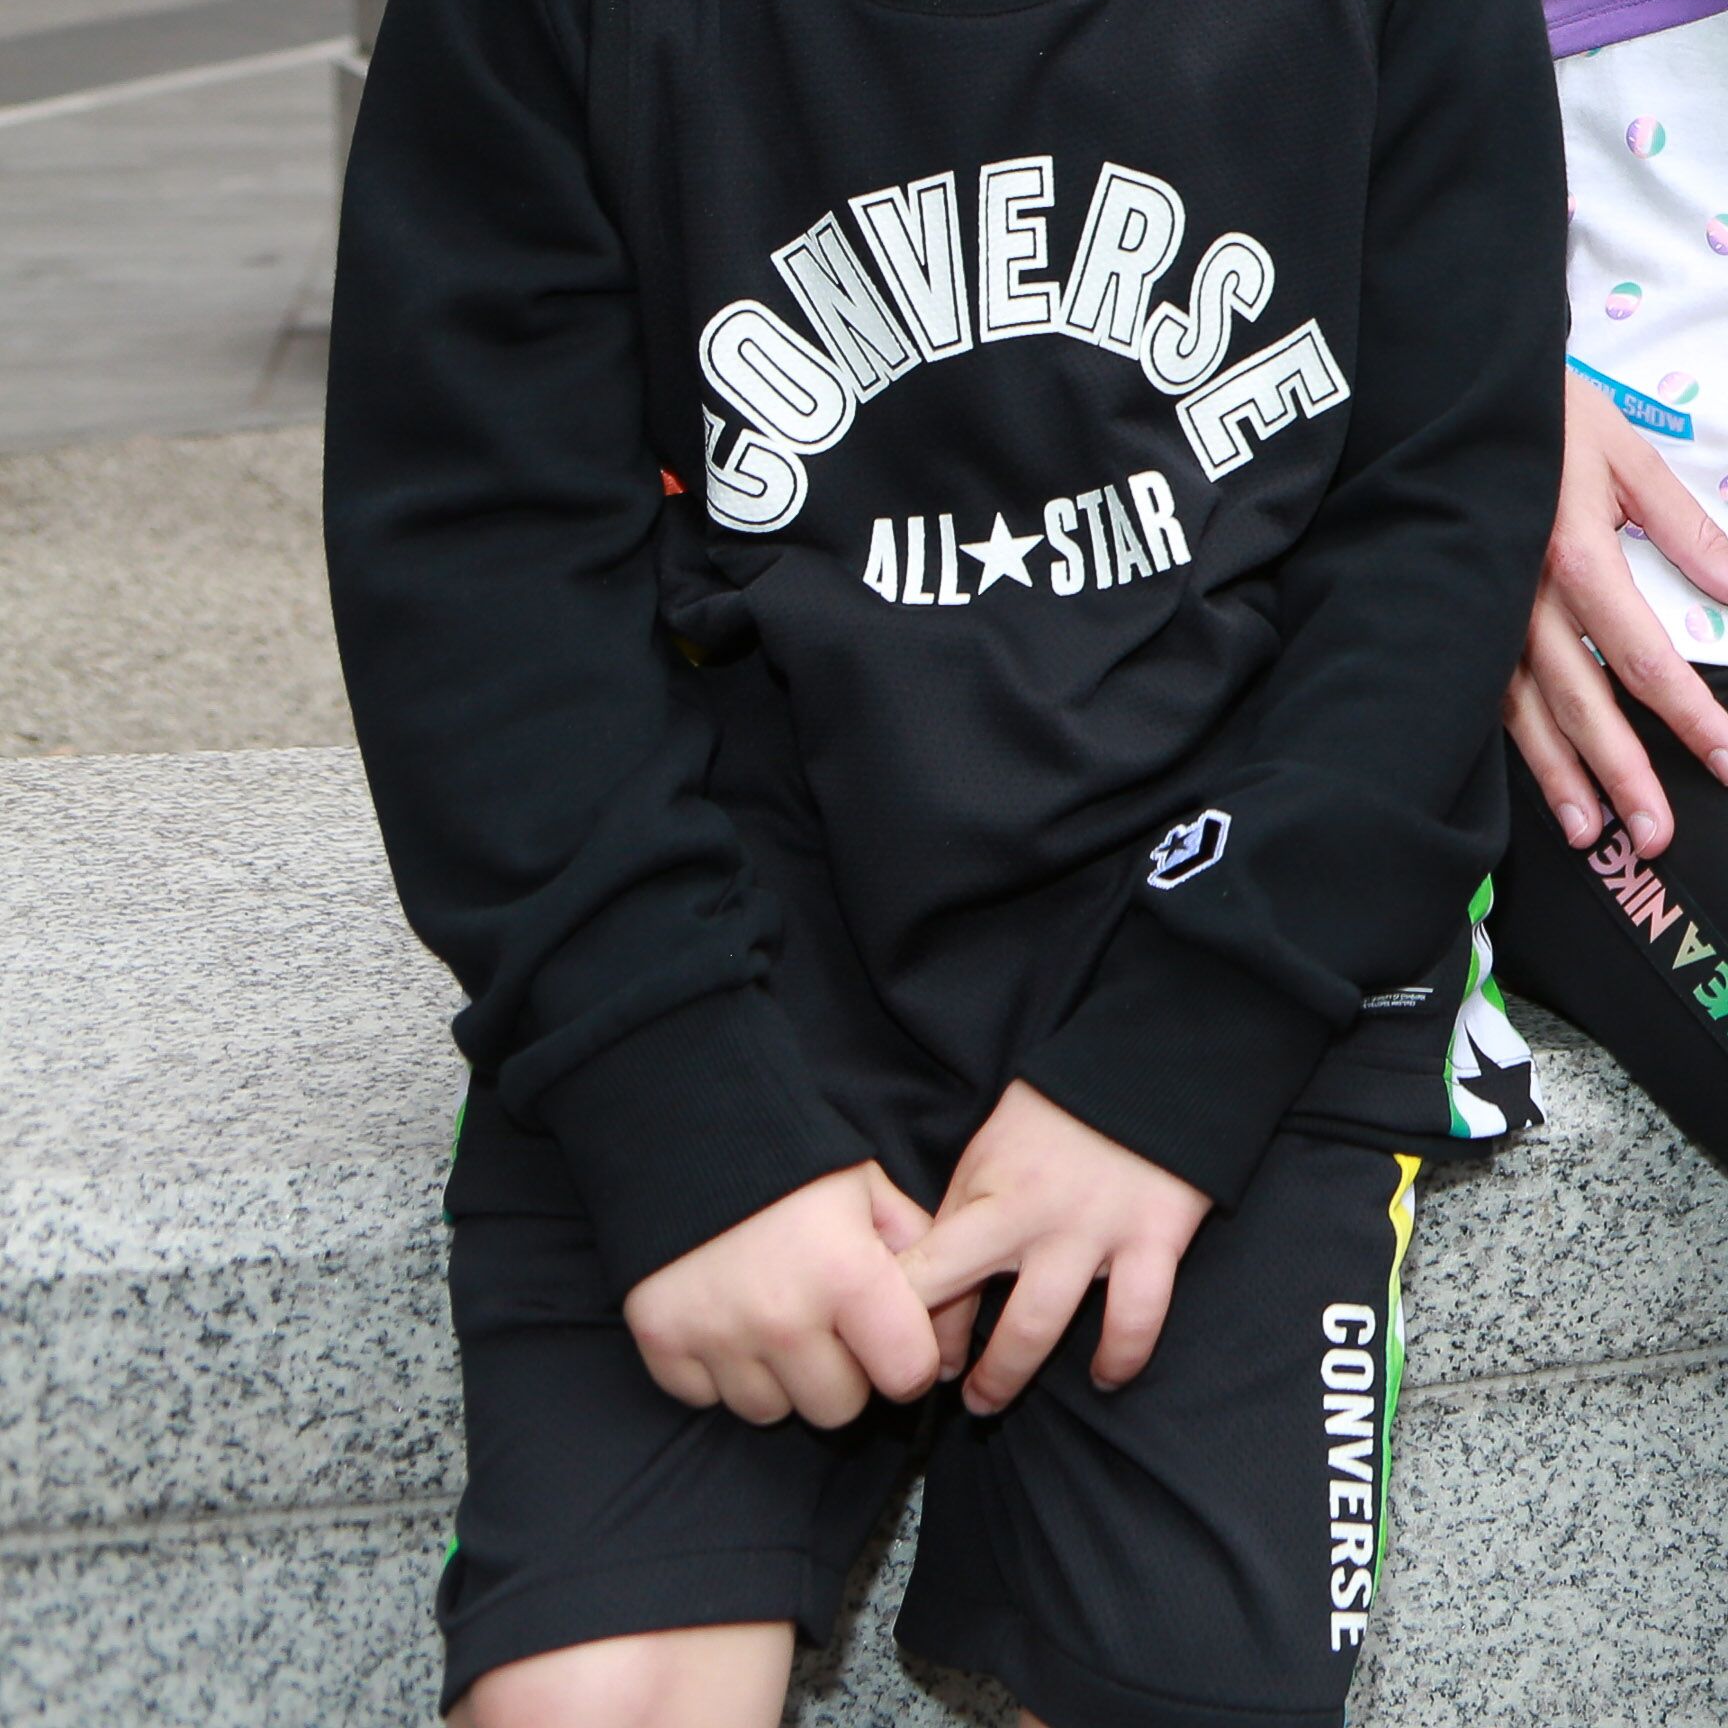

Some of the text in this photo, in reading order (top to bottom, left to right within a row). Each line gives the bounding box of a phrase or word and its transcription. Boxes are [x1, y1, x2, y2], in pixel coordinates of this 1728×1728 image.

[698, 154, 1351, 534] CONVERSE
[1622, 394, 1686, 433] SHOW
[862, 470, 1192, 606] ALL STAR
[1587, 829, 1684, 944] NIKE
[1671, 920, 1717, 970] A
[1320, 1302, 1377, 1653] CONVERSE
